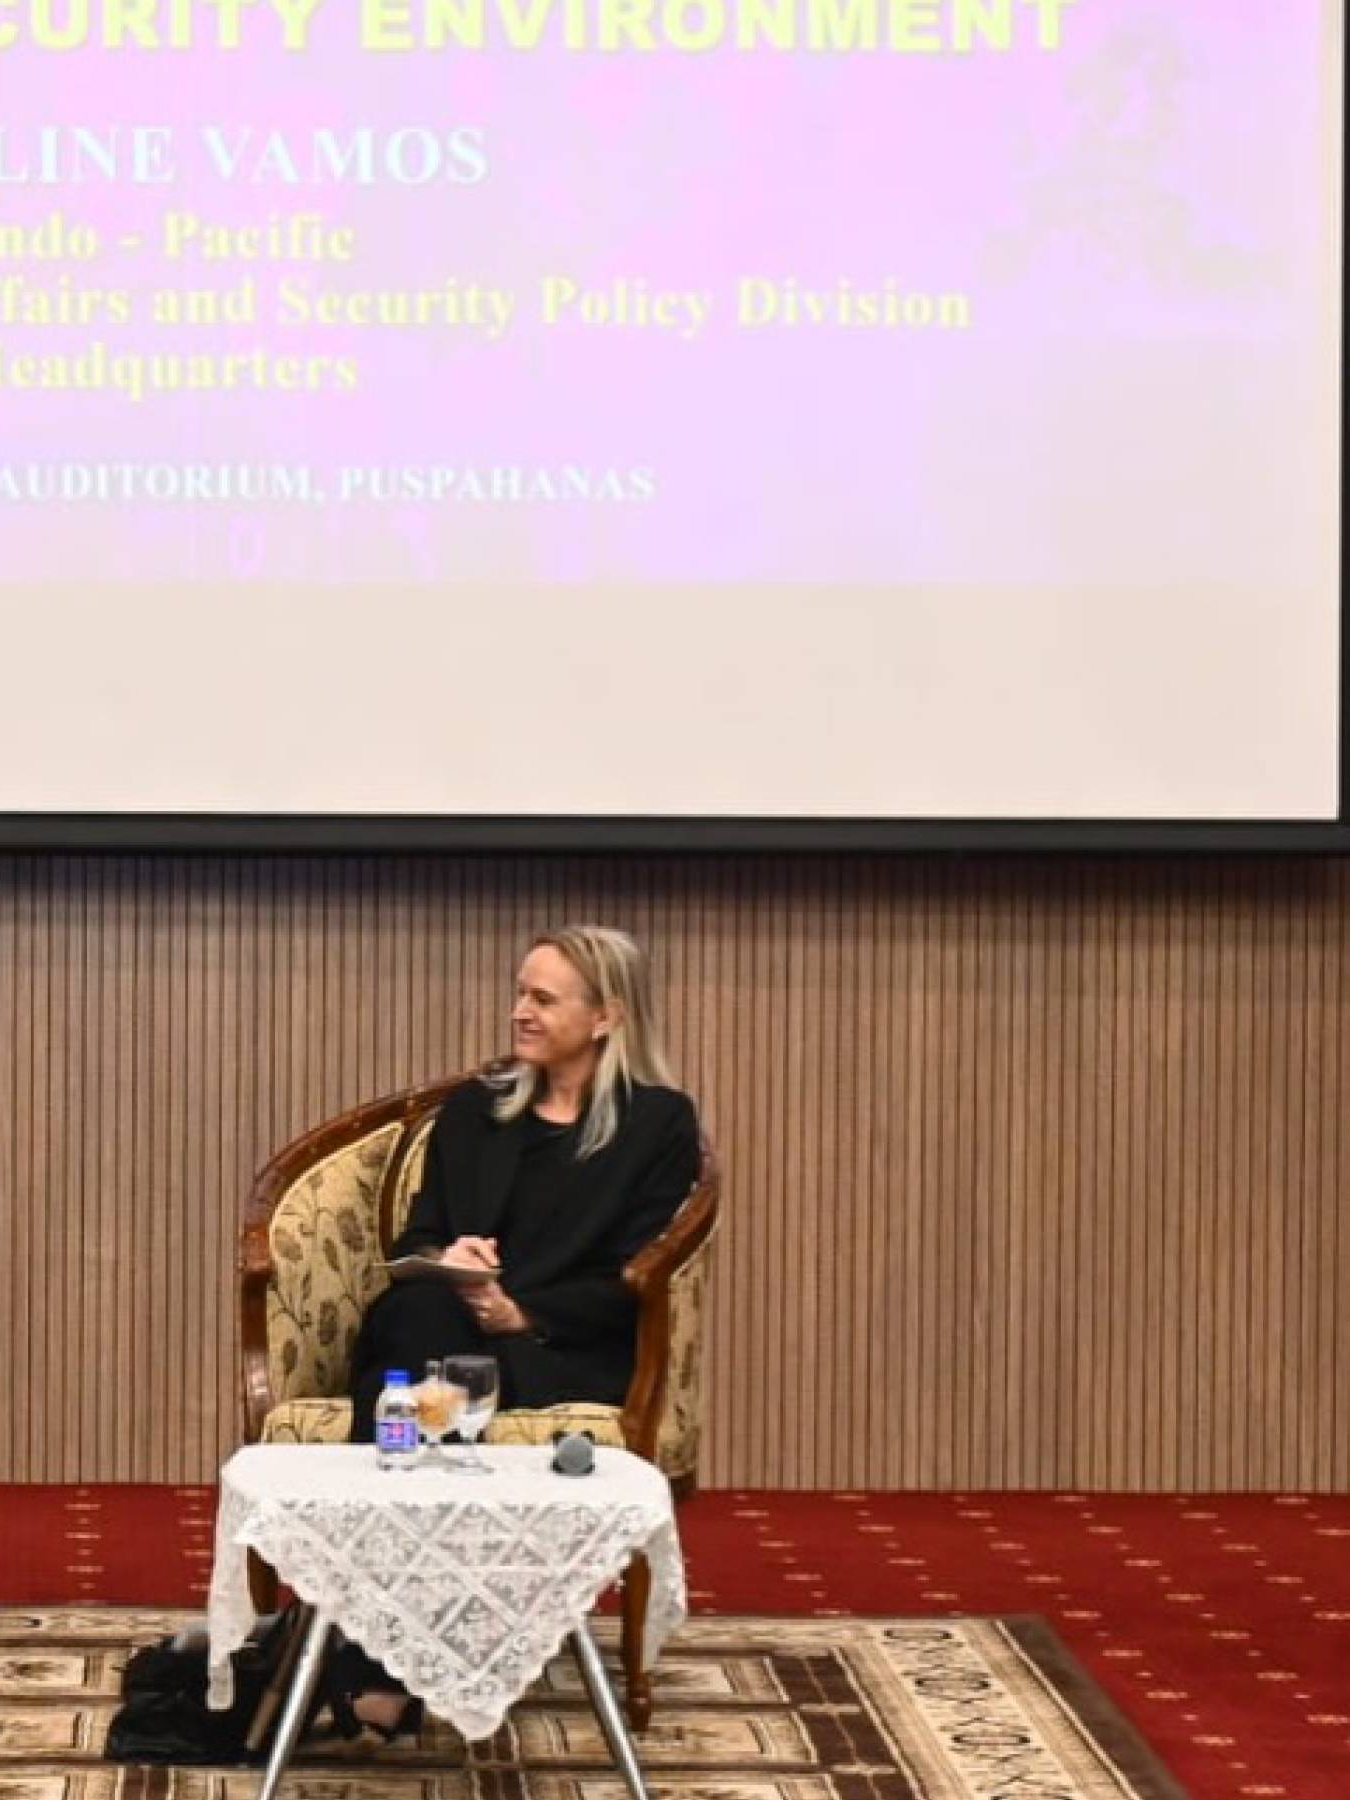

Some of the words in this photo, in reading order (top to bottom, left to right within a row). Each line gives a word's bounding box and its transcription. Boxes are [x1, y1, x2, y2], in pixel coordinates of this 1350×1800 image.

[359, 0, 1075, 54] ENVIRONMENT
[203, 126, 489, 186] VAMOS
[163, 211, 355, 263] Pacific
[152, 277, 255, 325] and
[278, 277, 515, 336] Security
[539, 276, 712, 336] Policy
[736, 276, 972, 328] Division
[340, 466, 657, 503] PUSPAHANAS
